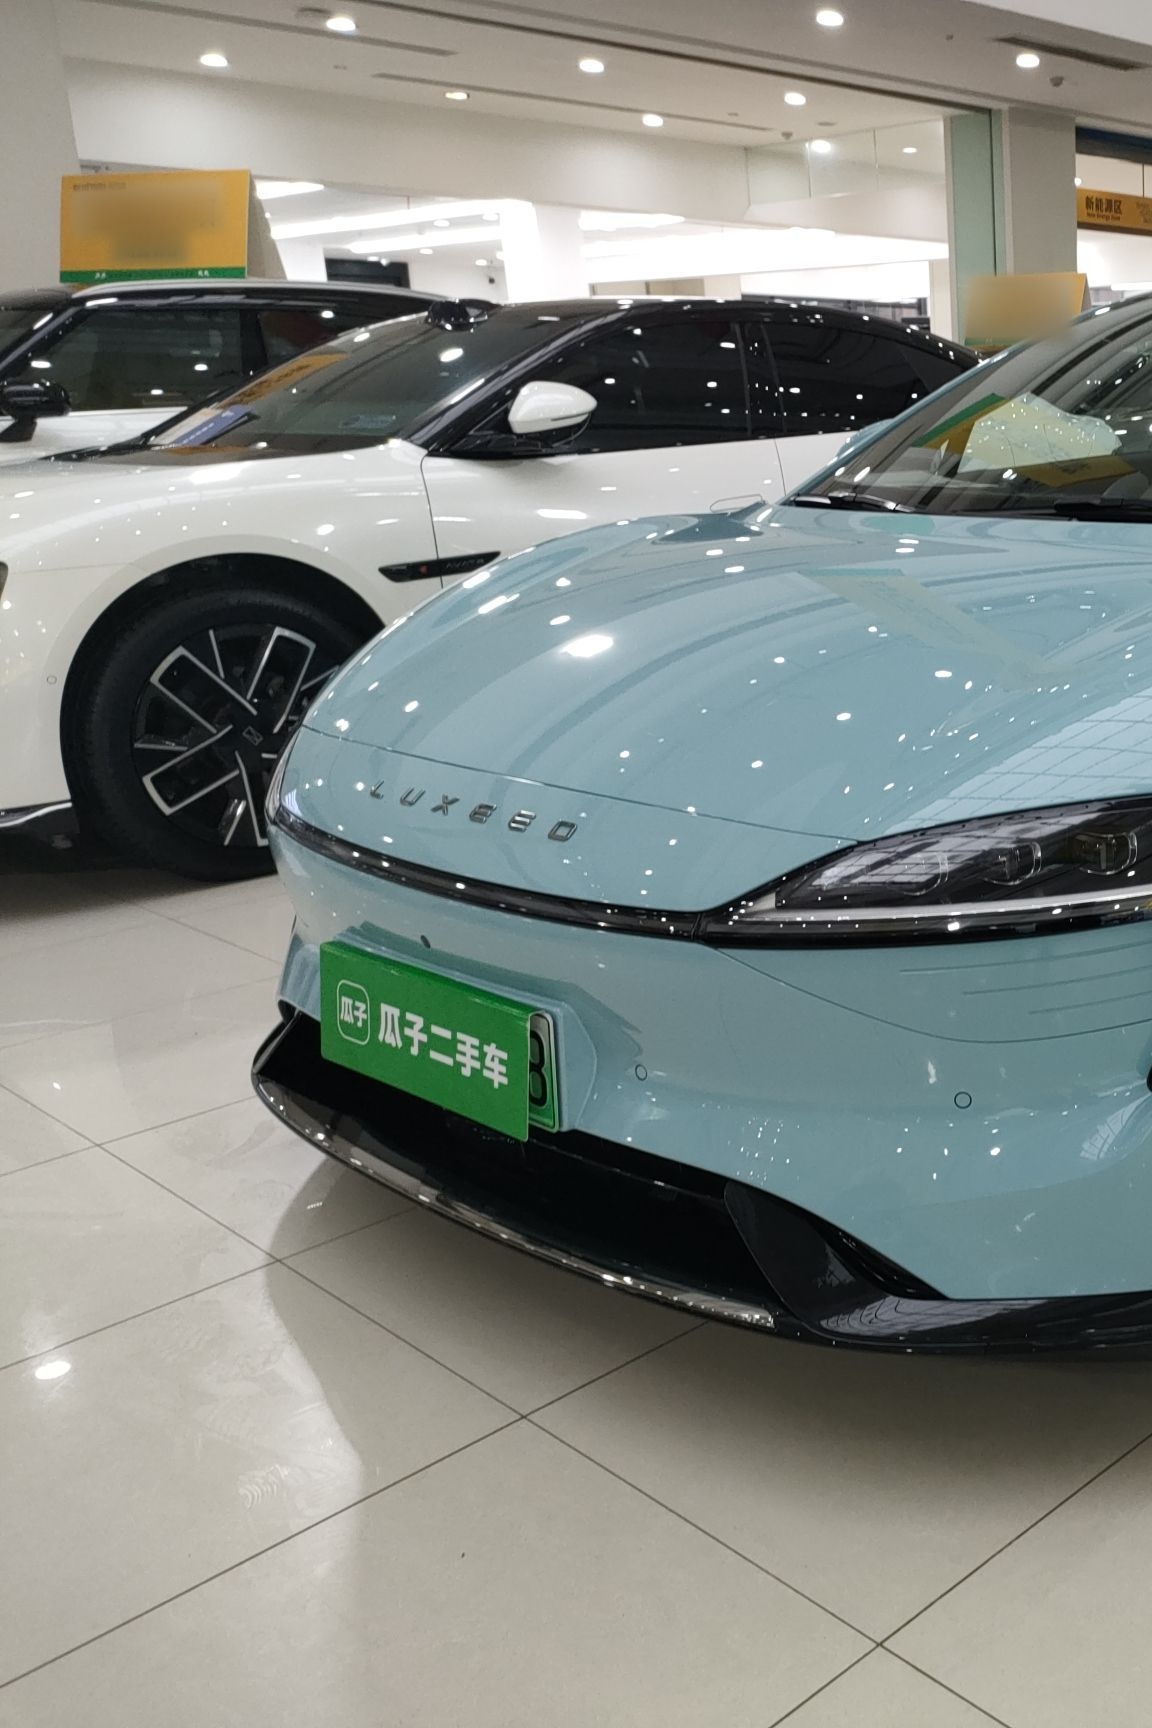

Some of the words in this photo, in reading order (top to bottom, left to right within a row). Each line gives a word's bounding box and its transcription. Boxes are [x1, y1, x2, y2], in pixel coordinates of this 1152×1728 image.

[1085, 195, 1122, 215] 新能源区
[370, 780, 578, 842] LUXEED
[340, 996, 368, 1028] 瓜子
[378, 1003, 509, 1089] 瓜子二手车
